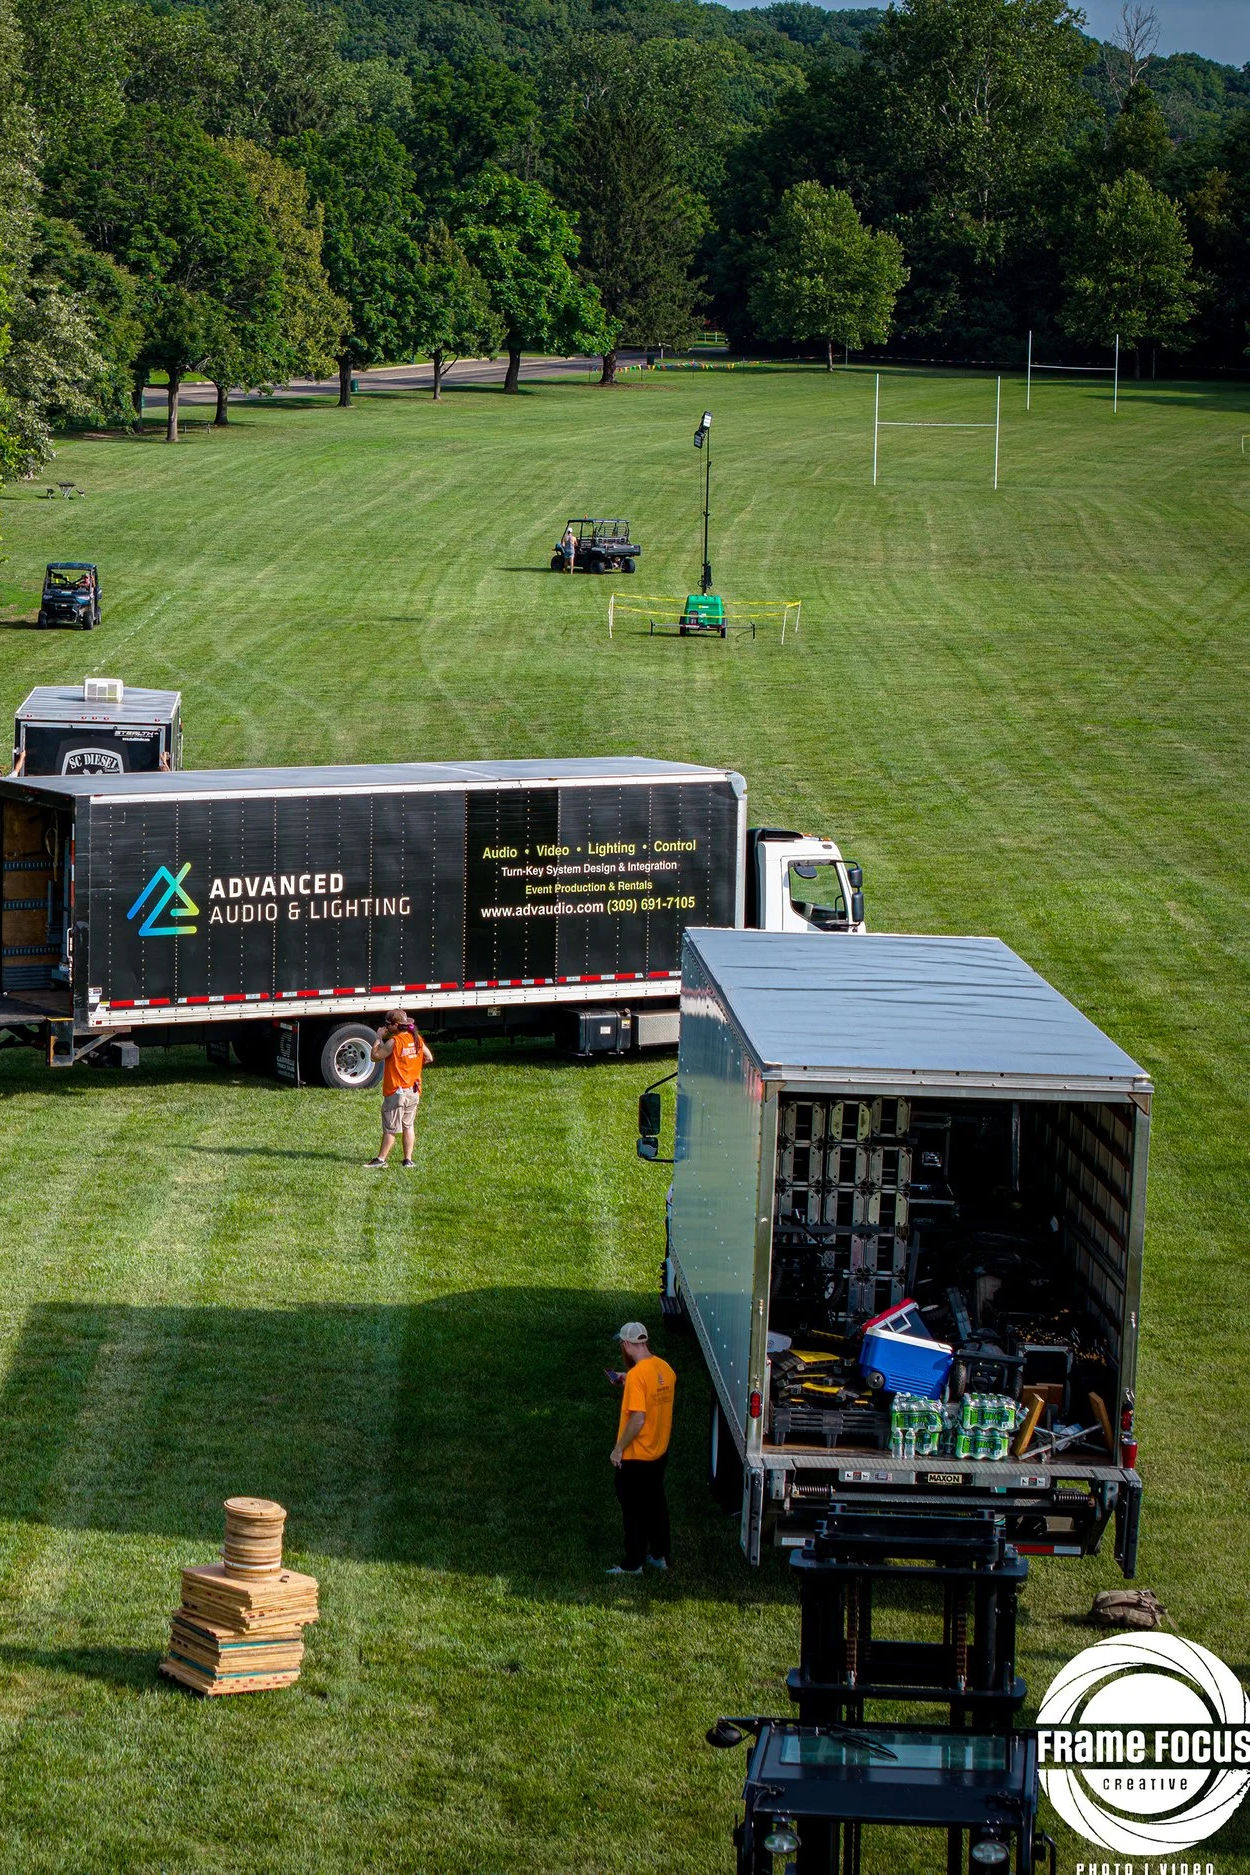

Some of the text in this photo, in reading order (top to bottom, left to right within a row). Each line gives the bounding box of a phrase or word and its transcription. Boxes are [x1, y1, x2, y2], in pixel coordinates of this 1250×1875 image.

[69, 756, 82, 769] SC
[482, 839, 696, 859] Audio Video Lighting Control
[501, 860, 677, 878] Turn-Key System Design & Integration
[209, 873, 344, 899] ADVANCED
[525, 880, 653, 895] Event Production & Rentals
[209, 897, 411, 925] AUDIO & LIGHTING
[481, 896, 695, 918] www.advaudio.com (309) 691-7105
[928, 1474, 960, 1482] MAXON
